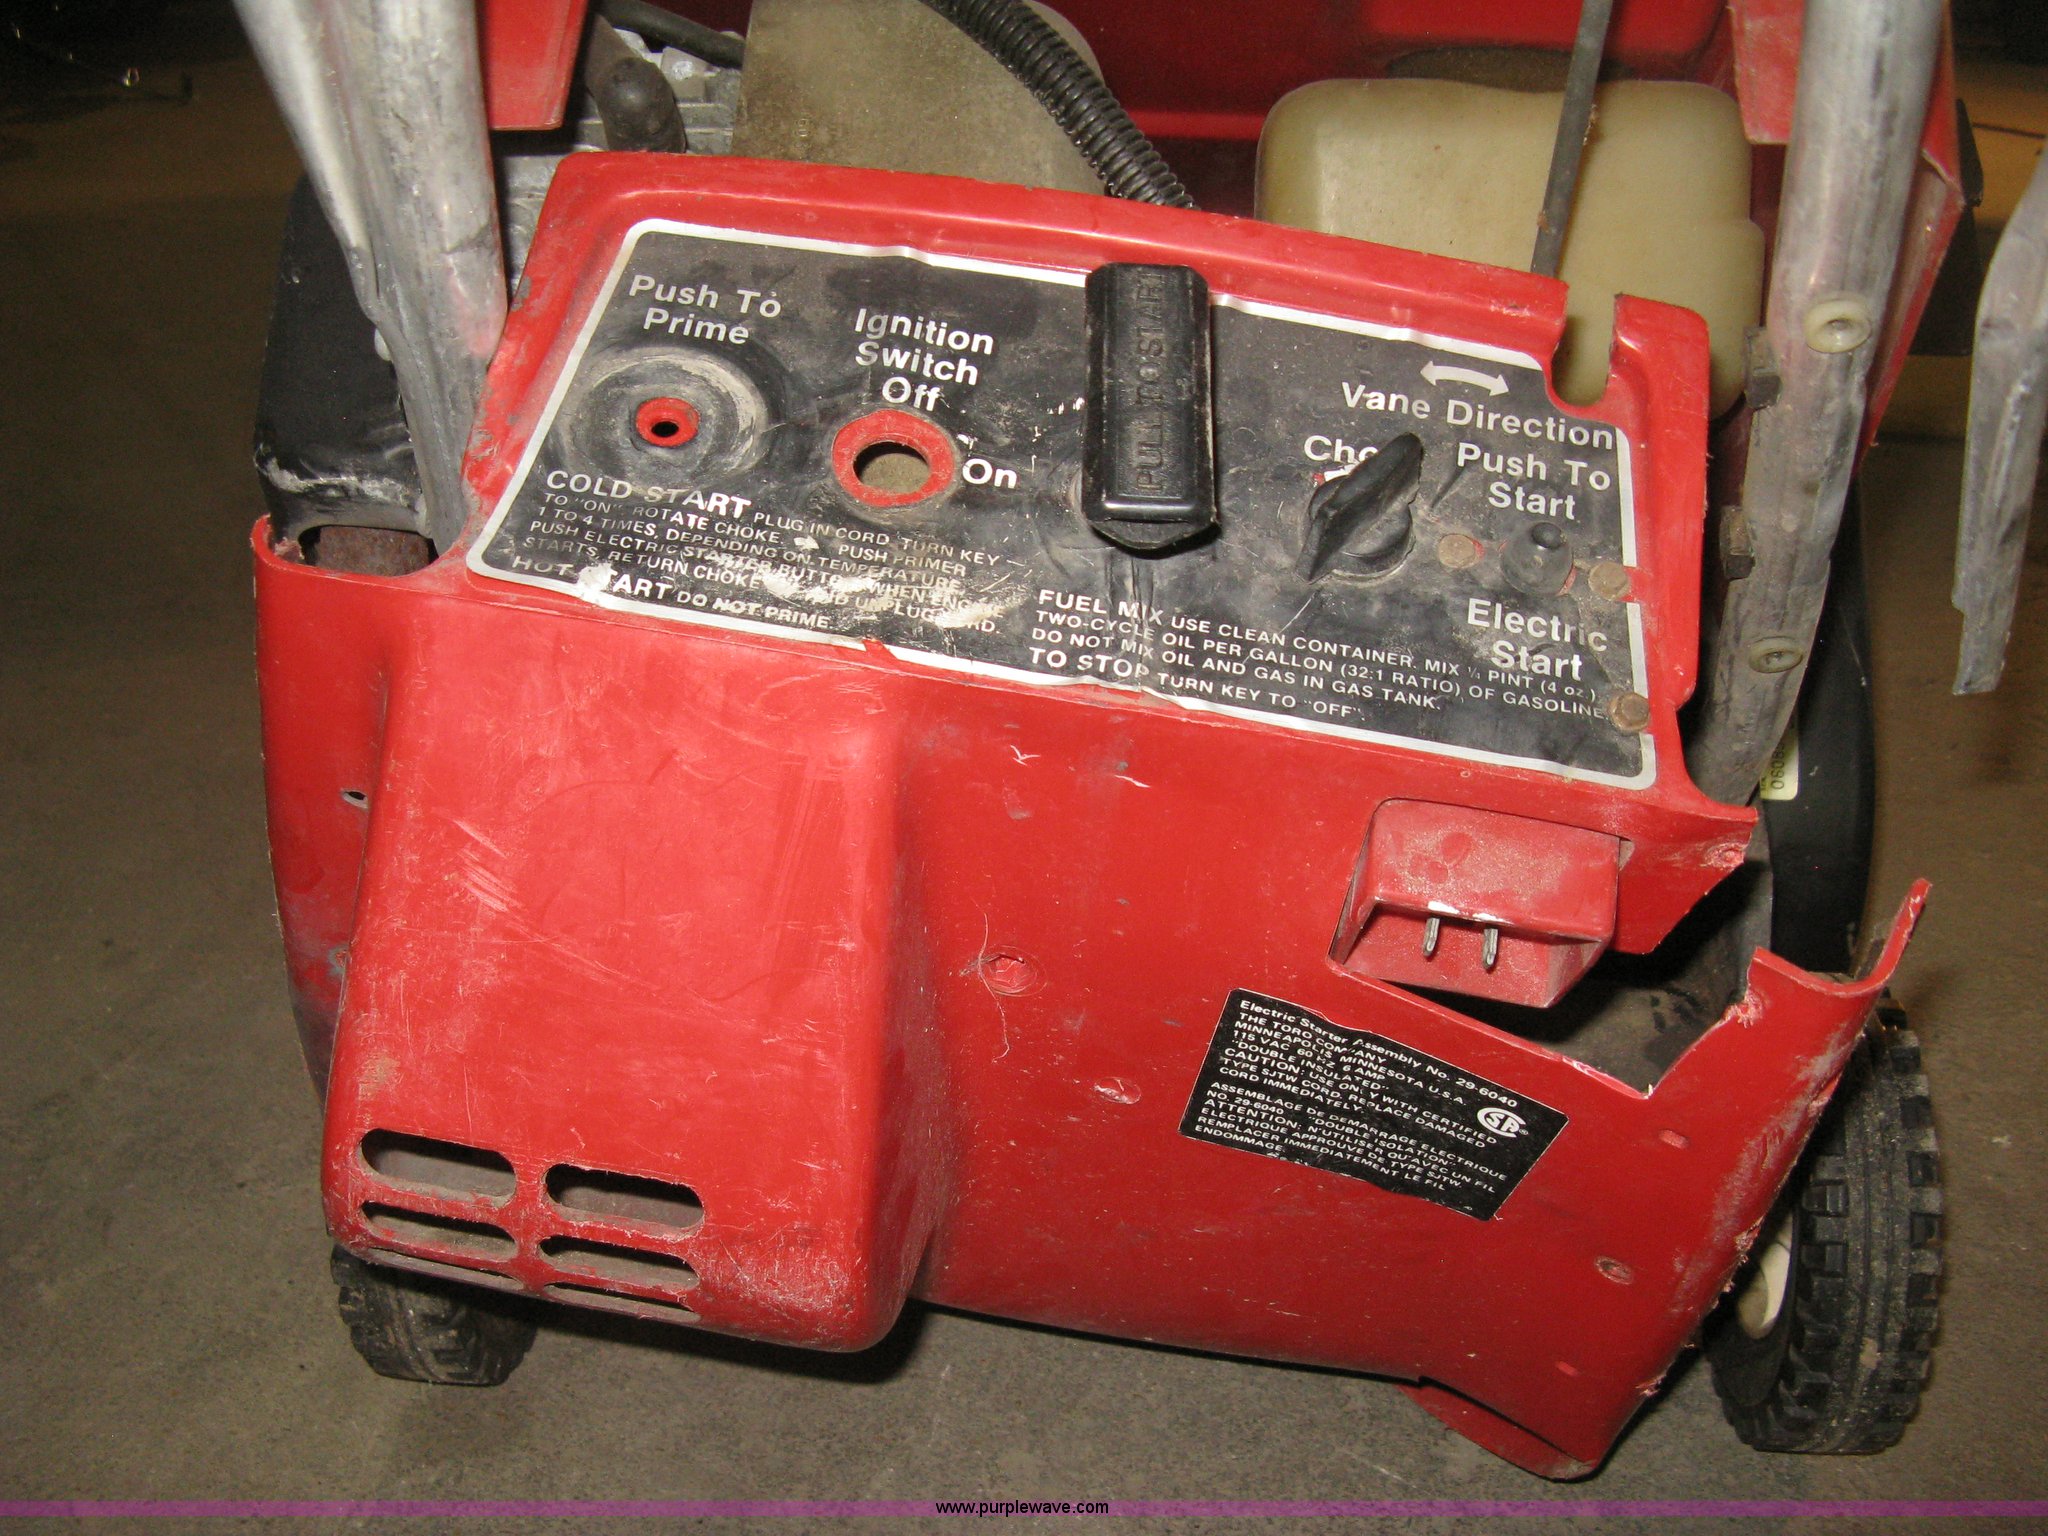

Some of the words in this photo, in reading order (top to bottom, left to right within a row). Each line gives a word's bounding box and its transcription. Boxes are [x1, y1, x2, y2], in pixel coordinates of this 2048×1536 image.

[629, 274, 719, 308] Push
[737, 289, 782, 318] To
[643, 306, 750, 345] Prime
[853, 308, 995, 355] Ignition
[855, 341, 980, 385] Switch
[881, 376, 942, 412] Off
[1341, 381, 1431, 419] Vane
[1446, 399, 1614, 450] Direction
[962, 457, 1018, 489] On
[1137, 410, 1166, 493] PULL
[1303, 435, 1379, 464] Cho
[1456, 442, 1547, 480] Push
[1564, 459, 1611, 491] To
[547, 470, 633, 499] COLD
[644, 485, 752, 519] START
[753, 512, 804, 531] PLUG
[809, 523, 830, 535] IN
[901, 537, 955, 558] TURN
[960, 549, 1001, 566] KEY
[1488, 481, 1576, 520] Start
[523, 537, 601, 560] STARTS,
[607, 551, 689, 576] RETURN
[692, 565, 761, 590] CHOKE
[530, 521, 579, 537] PUSH
[584, 530, 679, 554] ELECTRIC
[681, 546, 773, 573] STARTER
[779, 563, 859, 591] BUTTO
[869, 582, 927, 603] WHEN
[538, 507, 546, 517] 1
[554, 508, 578, 523] TO
[583, 515, 593, 525] 4
[601, 518, 659, 540] TIMES,
[666, 528, 781, 559] DEPENDING
[543, 492, 568, 506] TO
[632, 506, 709, 530] ROTATE
[714, 522, 785, 545] CHOKE.
[838, 545, 889, 562] PUSH
[893, 554, 967, 577] PRIMER
[512, 555, 573, 577] HOT
[677, 591, 708, 607] DO
[712, 597, 763, 616] NOT
[765, 606, 834, 629] PRIME.
[1038, 589, 1107, 614] FUEL
[1118, 601, 1164, 626] MIX
[1171, 615, 1211, 634] USE
[1218, 624, 1286, 646] CLEAN
[1293, 636, 1417, 669] CONTAINER.
[1424, 658, 1460, 676] MIX
[1488, 670, 1535, 689] PINT
[1540, 680, 1557, 695] (4
[1467, 598, 1608, 652] Electric
[1029, 647, 1068, 668] TO
[1077, 654, 1150, 679] STOP
[1157, 672, 1214, 694] TURN
[1221, 684, 1262, 702] KEY
[1268, 692, 1297, 708] TO
[1031, 628, 1062, 643] DO
[1069, 633, 1114, 650] NOT
[1120, 640, 1154, 660] MIX
[1162, 650, 1195, 667] OIL
[1202, 658, 1246, 676] AND
[1254, 667, 1296, 685] GAS
[1303, 675, 1326, 691] IN
[1331, 680, 1374, 699] GAS
[1382, 688, 1442, 711] TANK.
[1036, 610, 1155, 641] TWO-CYCLE
[1162, 633, 1196, 649] OIL
[1203, 639, 1242, 657] PER
[1249, 647, 1333, 672] GALLON
[1340, 663, 1383, 681] (32:1
[1391, 672, 1461, 698] RATIO)
[1469, 685, 1496, 700] OF
[1503, 691, 1610, 720] GASOLINE.
[1491, 640, 1583, 681] Start
[1233, 1030, 1256, 1041] 115
[1260, 1037, 1290, 1051] VAC
[1297, 1048, 1313, 1058] 60
[1342, 1064, 1351, 1072] 6
[1354, 1067, 1386, 1080] AMP
[1239, 1012, 1267, 1026] THE
[1272, 1021, 1313, 1040] TORO
[1240, 1000, 1297, 1023] Electric
[1299, 1017, 1348, 1044] Starter
[1352, 1038, 1422, 1068] Assembly
[1425, 1065, 1451, 1082] No.
[1456, 1078, 1518, 1107] 29-6040
[1219, 1066, 1260, 1082] CORD
[1263, 1078, 1365, 1114] IMMEDIATELY.
[1234, 1021, 1333, 1059] MINNEAPOLIS
[1339, 1055, 1424, 1088] MINNESOTA
[1428, 1085, 1467, 1106] U.S.A.
[1207, 1089, 1230, 1101] NO.
[1234, 1097, 1284, 1115] 29-6040
[1223, 1058, 1258, 1072] TYPE
[1261, 1066, 1298, 1083] SJTW
[1301, 1079, 1343, 1100] CORD.
[1348, 1093, 1411, 1119] REPLACE
[1415, 1116, 1486, 1148] DAMAGED
[1224, 1048, 1306, 1076] CAUTION:
[1309, 1071, 1335, 1087] USE
[1382, 1095, 1418, 1113] WITH
[1422, 1110, 1498, 1144] CERTIFIED
[1197, 1116, 1280, 1142] REMPLACER
[1284, 1137, 1400, 1177] IMMEDIATEMENT
[1404, 1172, 1421, 1182] LE
[1425, 1178, 1446, 1191] FIL
[1201, 1107, 1289, 1134] ELECTRIQUE
[1291, 1131, 1365, 1154] APPROUVE
[1367, 1152, 1386, 1164] DE
[1391, 1160, 1425, 1174] TYPE
[1427, 1171, 1463, 1188] SJTW.
[1204, 1099, 1302, 1130] ATTENTION:
[1307, 1126, 1384, 1155] N'UTILISER
[1387, 1152, 1449, 1174] QU'AVEC
[1451, 1171, 1471, 1183] UN
[1475, 1180, 1496, 1194] FIL
[1210, 1081, 1303, 1111] ASSEMBLAGE
[1306, 1107, 1325, 1118] DE
[1329, 1114, 1418, 1146] DEMARRAGE
[1421, 1143, 1508, 1181] ELECTRIQUE
